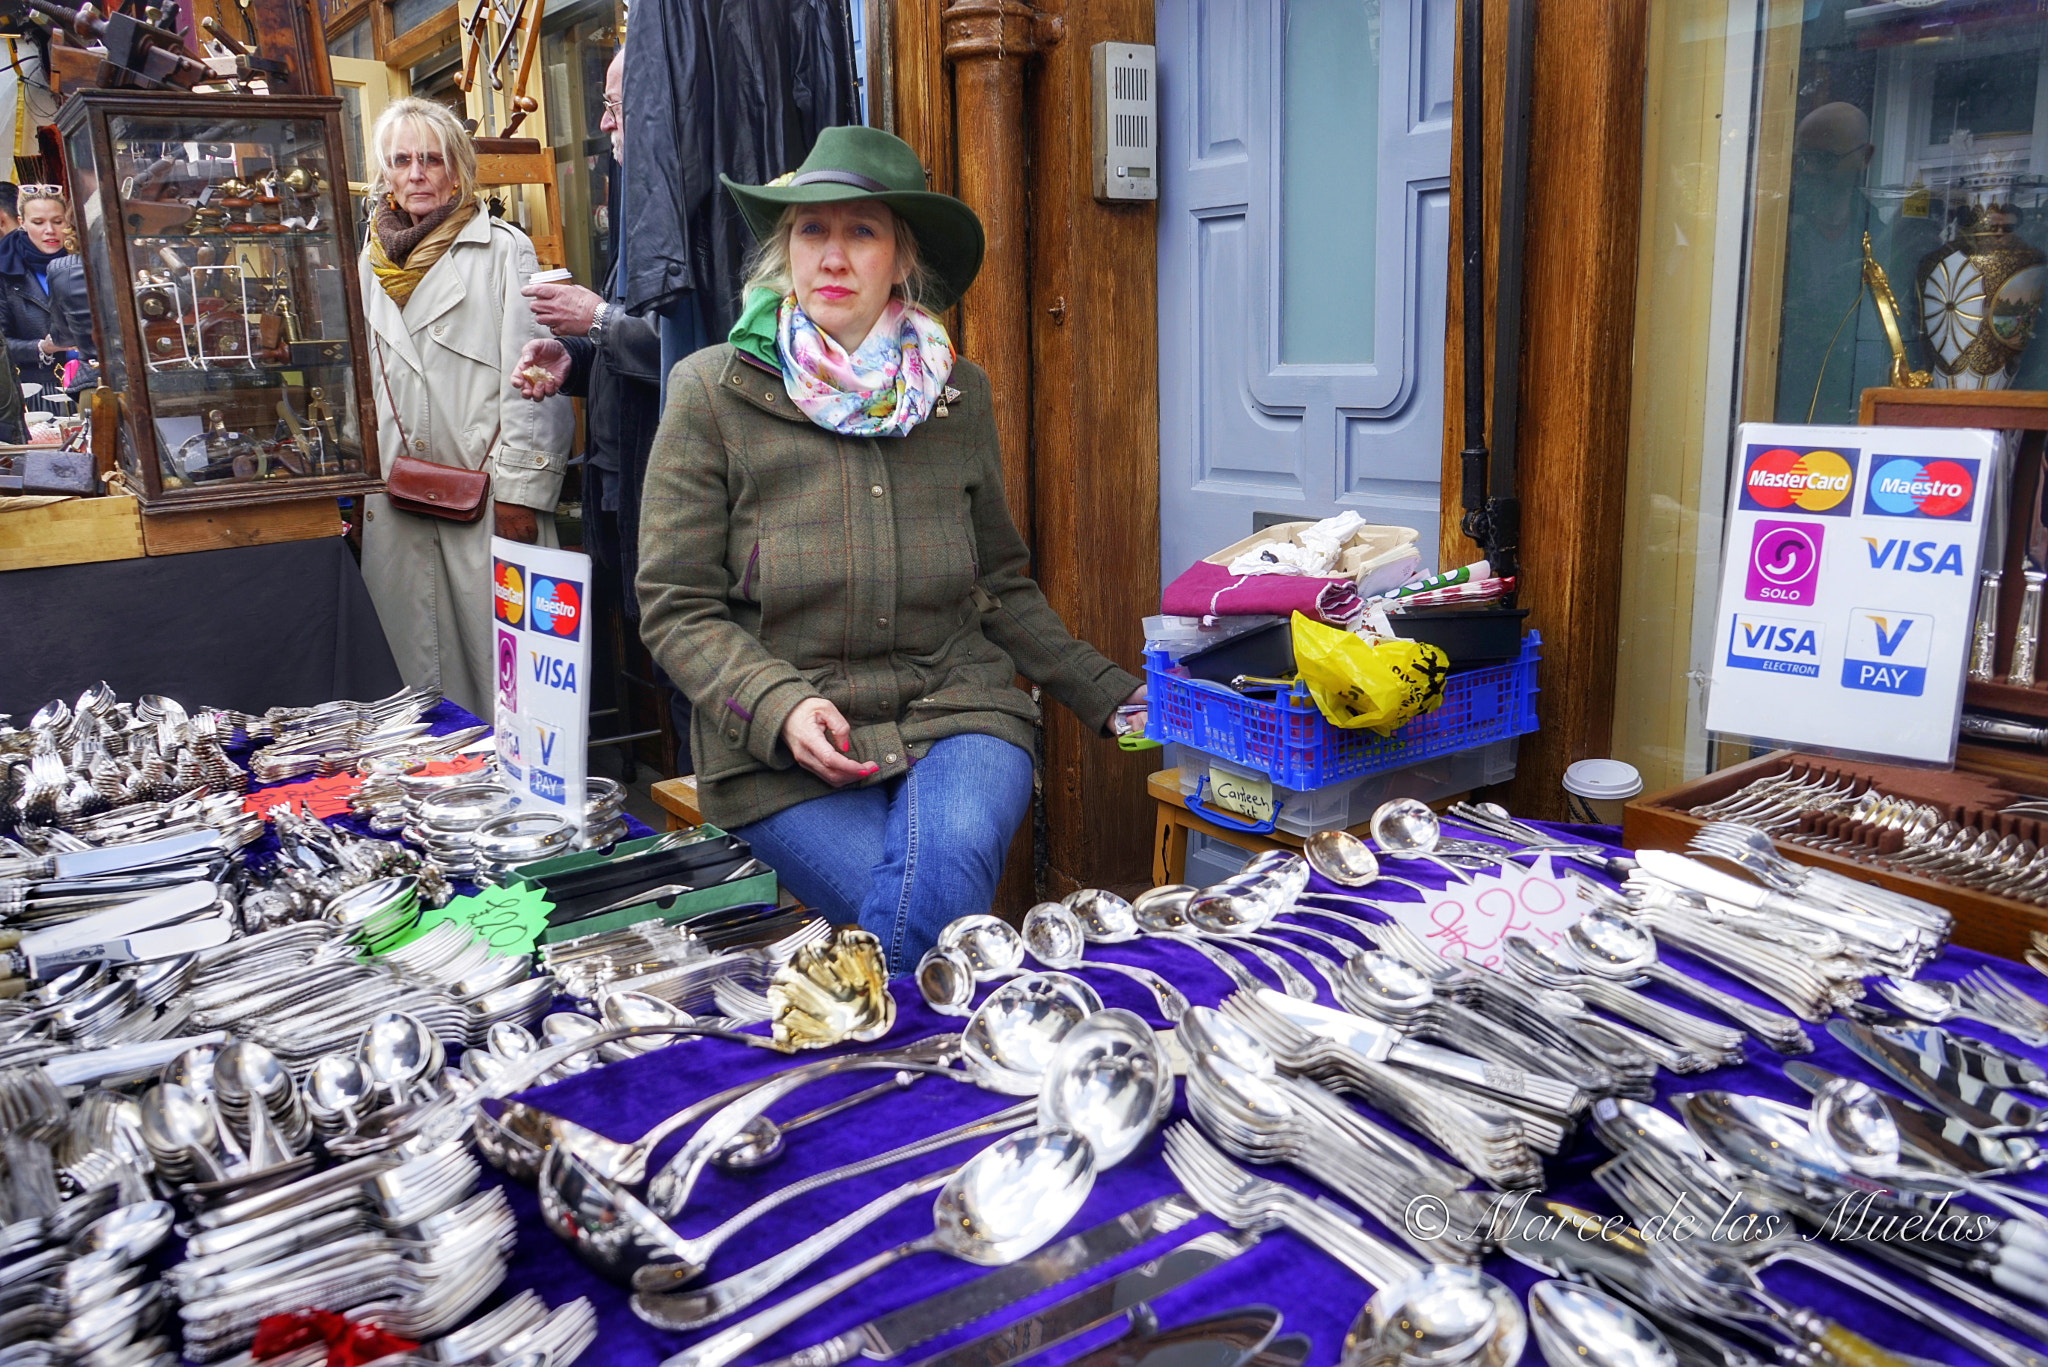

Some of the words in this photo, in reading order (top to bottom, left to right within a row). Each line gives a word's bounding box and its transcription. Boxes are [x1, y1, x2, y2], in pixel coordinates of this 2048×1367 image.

[1748, 470, 1849, 491] MasterCard
[1879, 478, 1962, 498] Maestro
[1861, 536, 1963, 576] VISA
[1759, 587, 1800, 600] SOLO
[535, 596, 575, 618] Maestro
[1740, 622, 1817, 656] VISA
[530, 651, 577, 693] VISA
[1762, 661, 1815, 676] ELECTRON
[1859, 665, 1909, 689] PAY
[535, 773, 558, 797] PAY
[1426, 877, 1565, 959] £20
